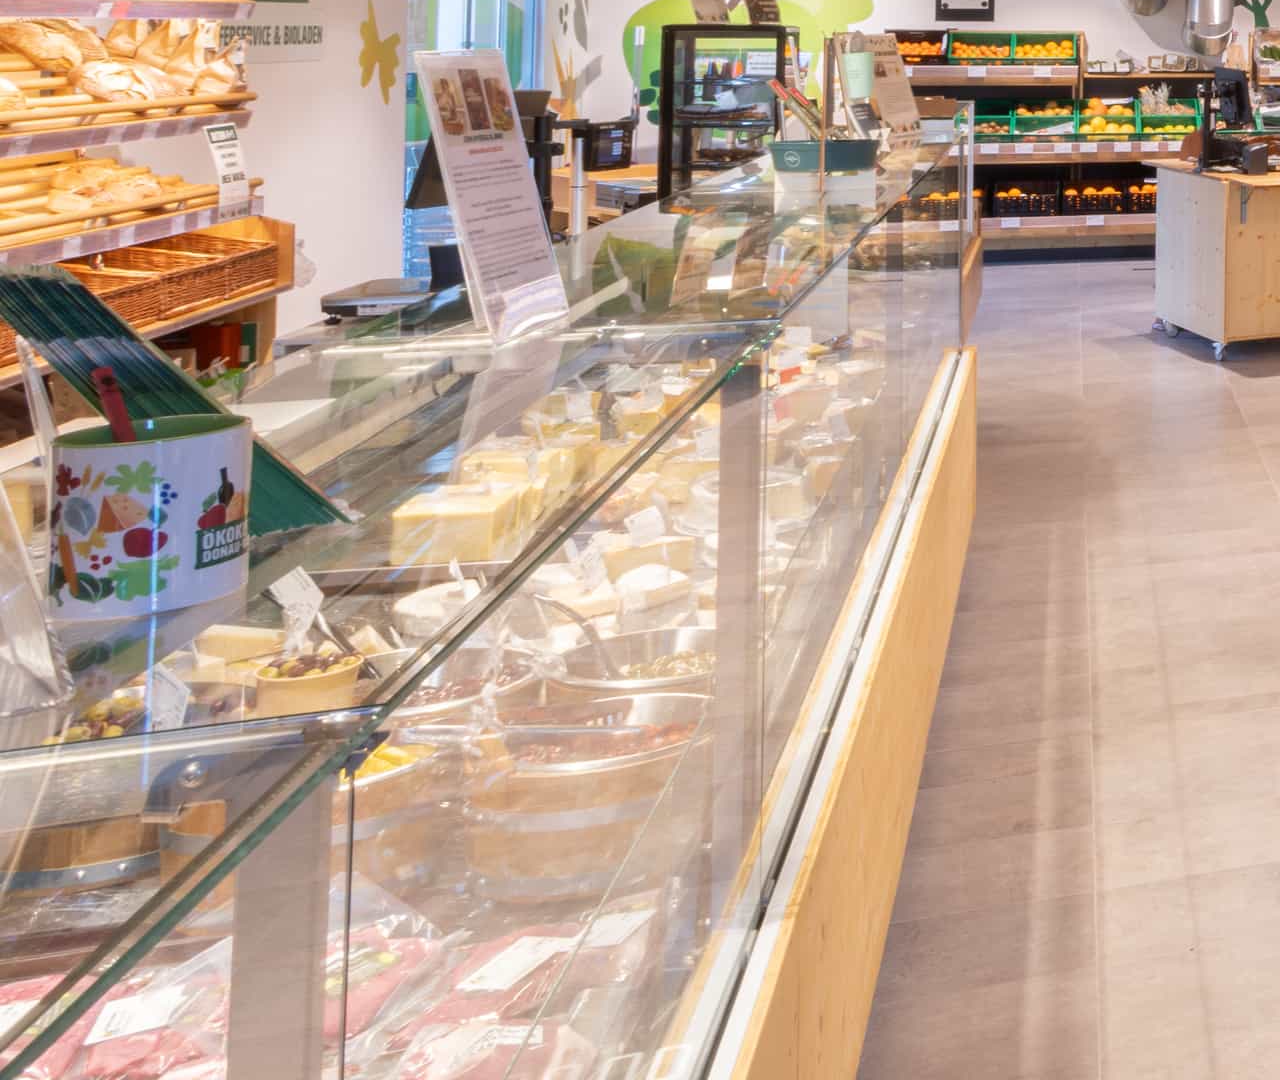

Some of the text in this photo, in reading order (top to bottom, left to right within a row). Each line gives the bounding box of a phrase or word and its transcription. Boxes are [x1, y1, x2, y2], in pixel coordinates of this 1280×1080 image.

[220, 24, 272, 46] FERSERVICE
[283, 25, 323, 45] BIOLADEN
[203, 524, 241, 550] ÖKOK
[203, 541, 241, 563] DONAU
